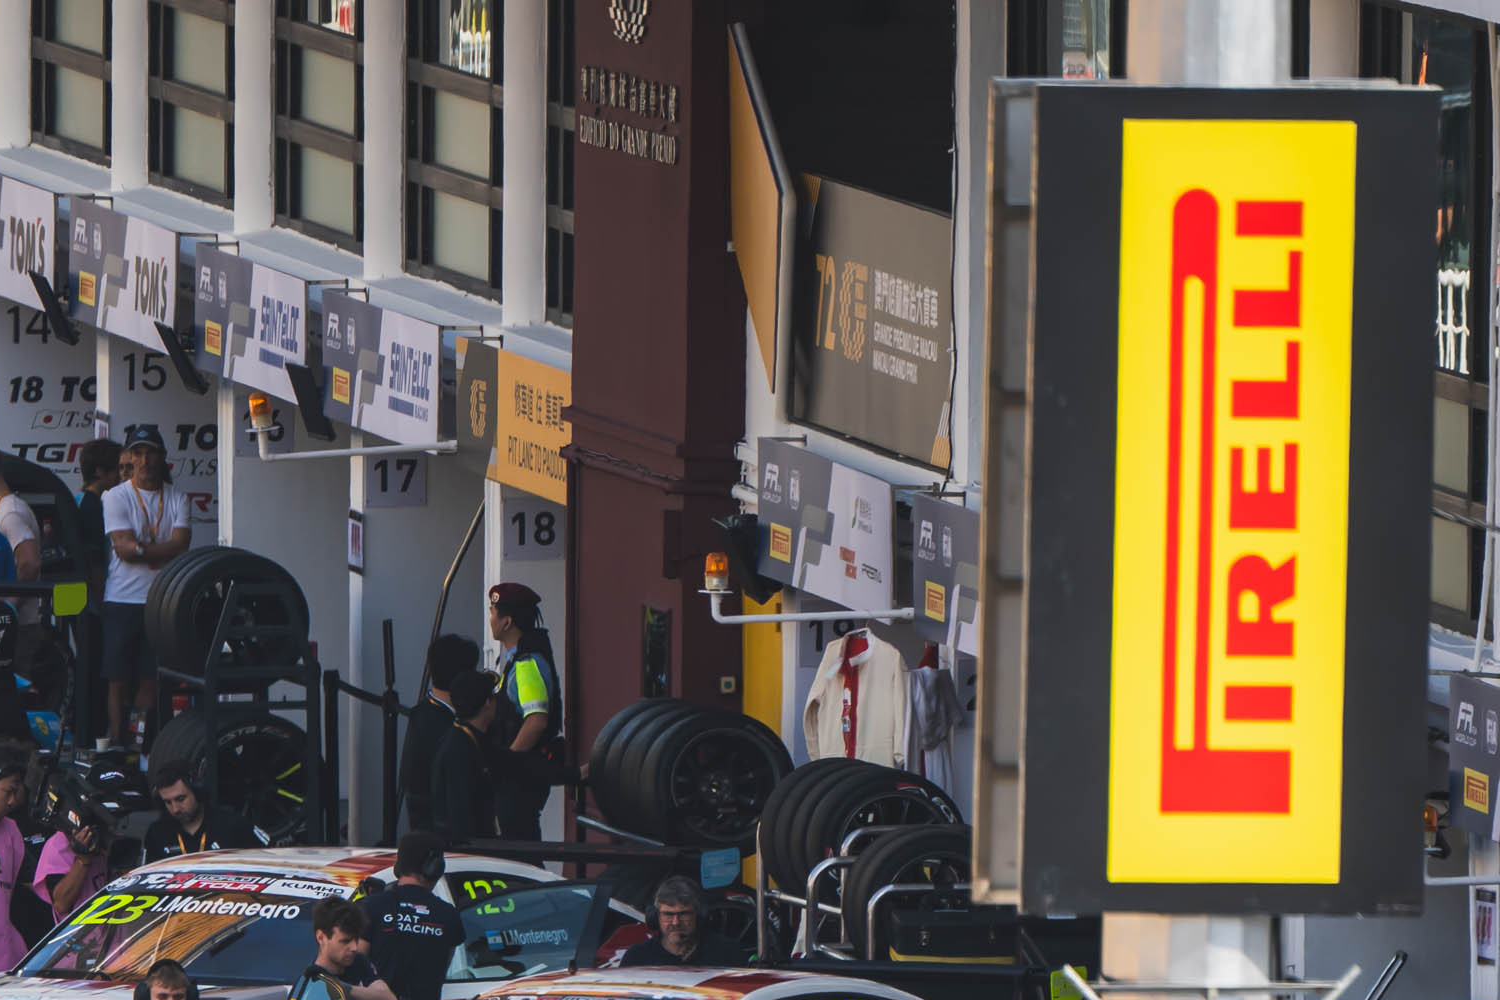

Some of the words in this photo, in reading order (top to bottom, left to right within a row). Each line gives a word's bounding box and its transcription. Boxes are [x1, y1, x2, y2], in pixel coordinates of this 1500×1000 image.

[9, 215, 46, 276] TOM'S
[134, 255, 168, 323] TOM'S
[816, 253, 836, 351] 72
[6, 305, 51, 345] 14
[9, 376, 44, 403] 18
[123, 352, 168, 392] 15
[507, 434, 518, 465] PIT
[519, 439, 534, 471] LANE
[374, 459, 418, 493] 17
[1160, 188, 1304, 815] PIRELLI
[511, 512, 556, 546] 18
[196, 881, 264, 893] TOUR
[280, 880, 346, 894] KUMHO
[68, 893, 160, 926] 123
[397, 922, 444, 938] RACING
